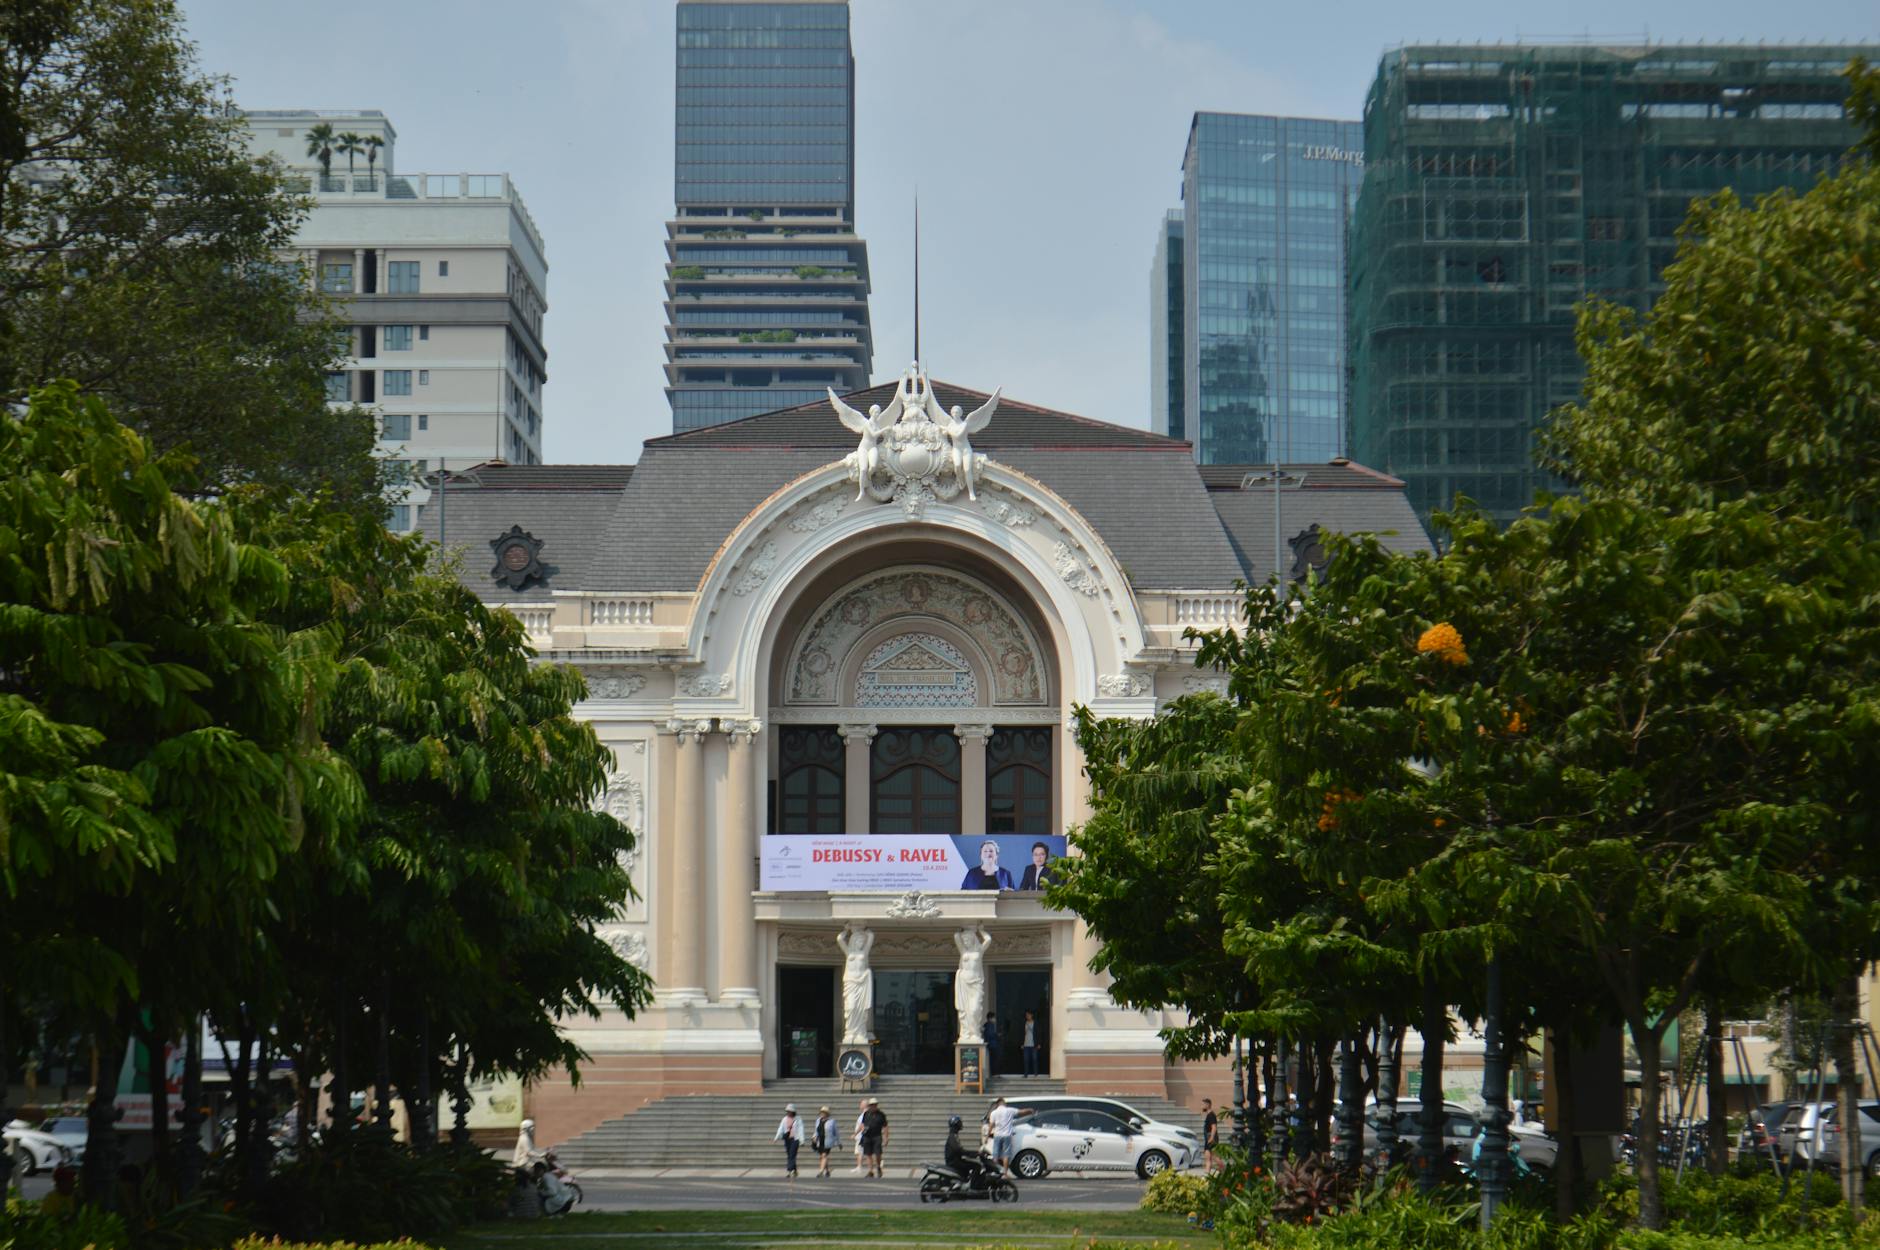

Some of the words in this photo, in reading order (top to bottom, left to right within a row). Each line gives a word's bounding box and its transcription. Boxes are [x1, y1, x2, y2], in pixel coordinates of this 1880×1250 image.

[812, 849, 882, 863] DEBUSSY
[887, 854, 896, 863] &
[900, 849, 948, 863] RAVEL
